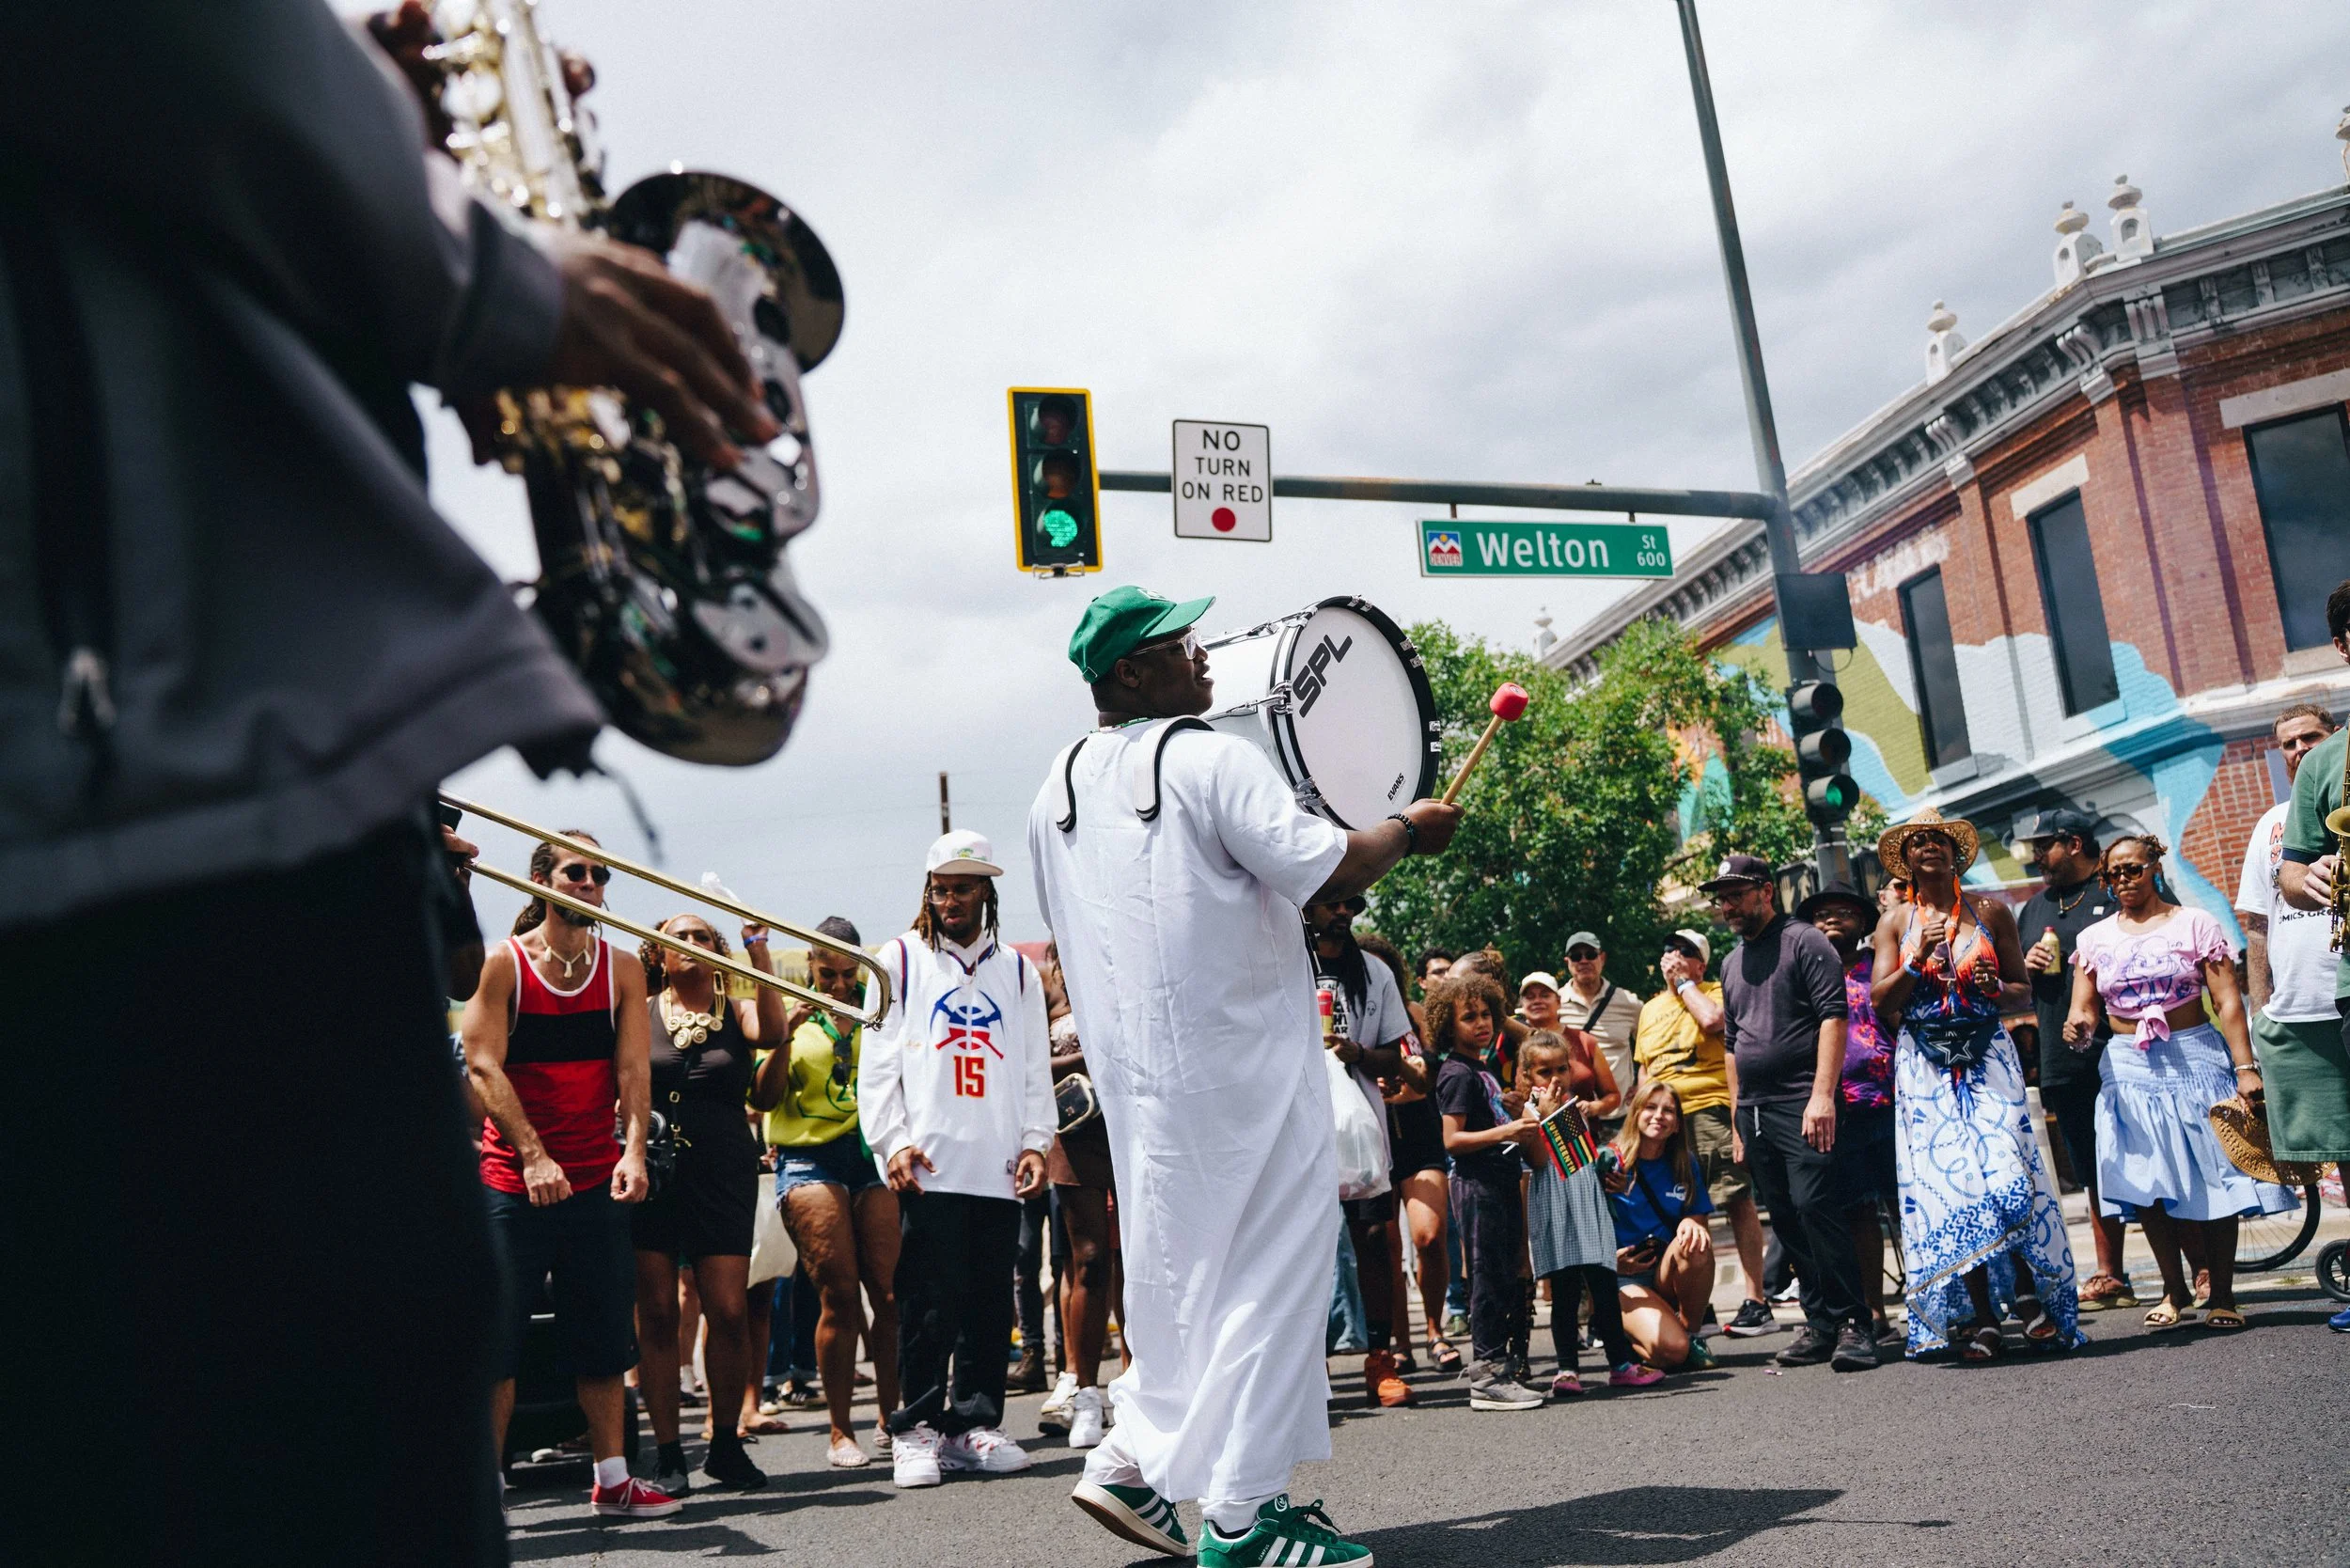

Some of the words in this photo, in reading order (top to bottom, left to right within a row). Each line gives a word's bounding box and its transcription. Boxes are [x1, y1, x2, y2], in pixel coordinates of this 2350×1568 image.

[1203, 429, 1240, 451] NO
[1195, 457, 1250, 477] TURN
[1182, 481, 1210, 500] ON
[1223, 484, 1263, 503] RED
[1476, 530, 1609, 568] Welton
[1641, 534, 1656, 550] St
[1430, 554, 1462, 565] DENVER
[1637, 551, 1667, 568] 600
[1292, 634, 1354, 718] SPL
[1387, 772, 1404, 801] EVANS
[952, 1055, 985, 1098] 15
[1546, 1121, 1576, 1173] JUNETEENTH
